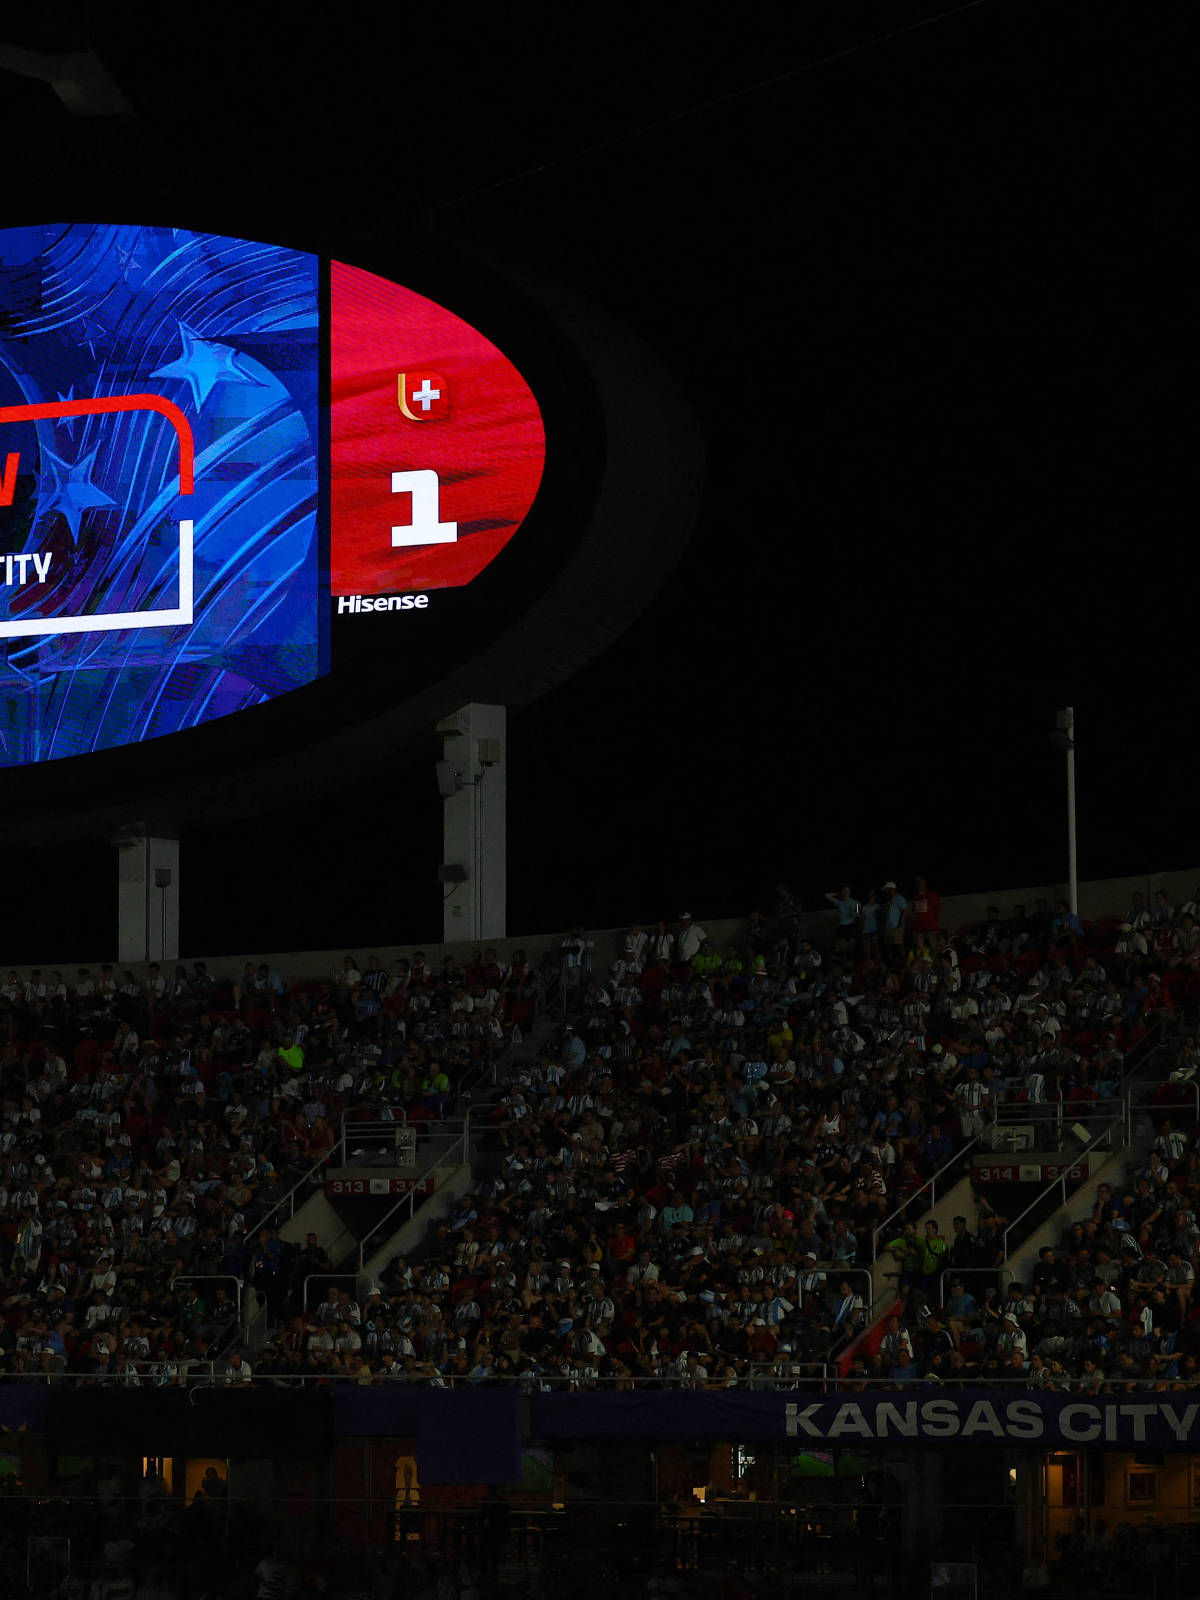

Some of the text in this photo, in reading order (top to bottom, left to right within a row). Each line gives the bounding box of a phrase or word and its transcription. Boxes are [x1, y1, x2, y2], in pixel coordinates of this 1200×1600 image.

[392, 469, 458, 547] 1
[337, 594, 429, 615] Hisense
[979, 1167, 1013, 1181] 314
[332, 1180, 365, 1193] 313
[784, 1399, 1200, 1442] KANSAS CITY
